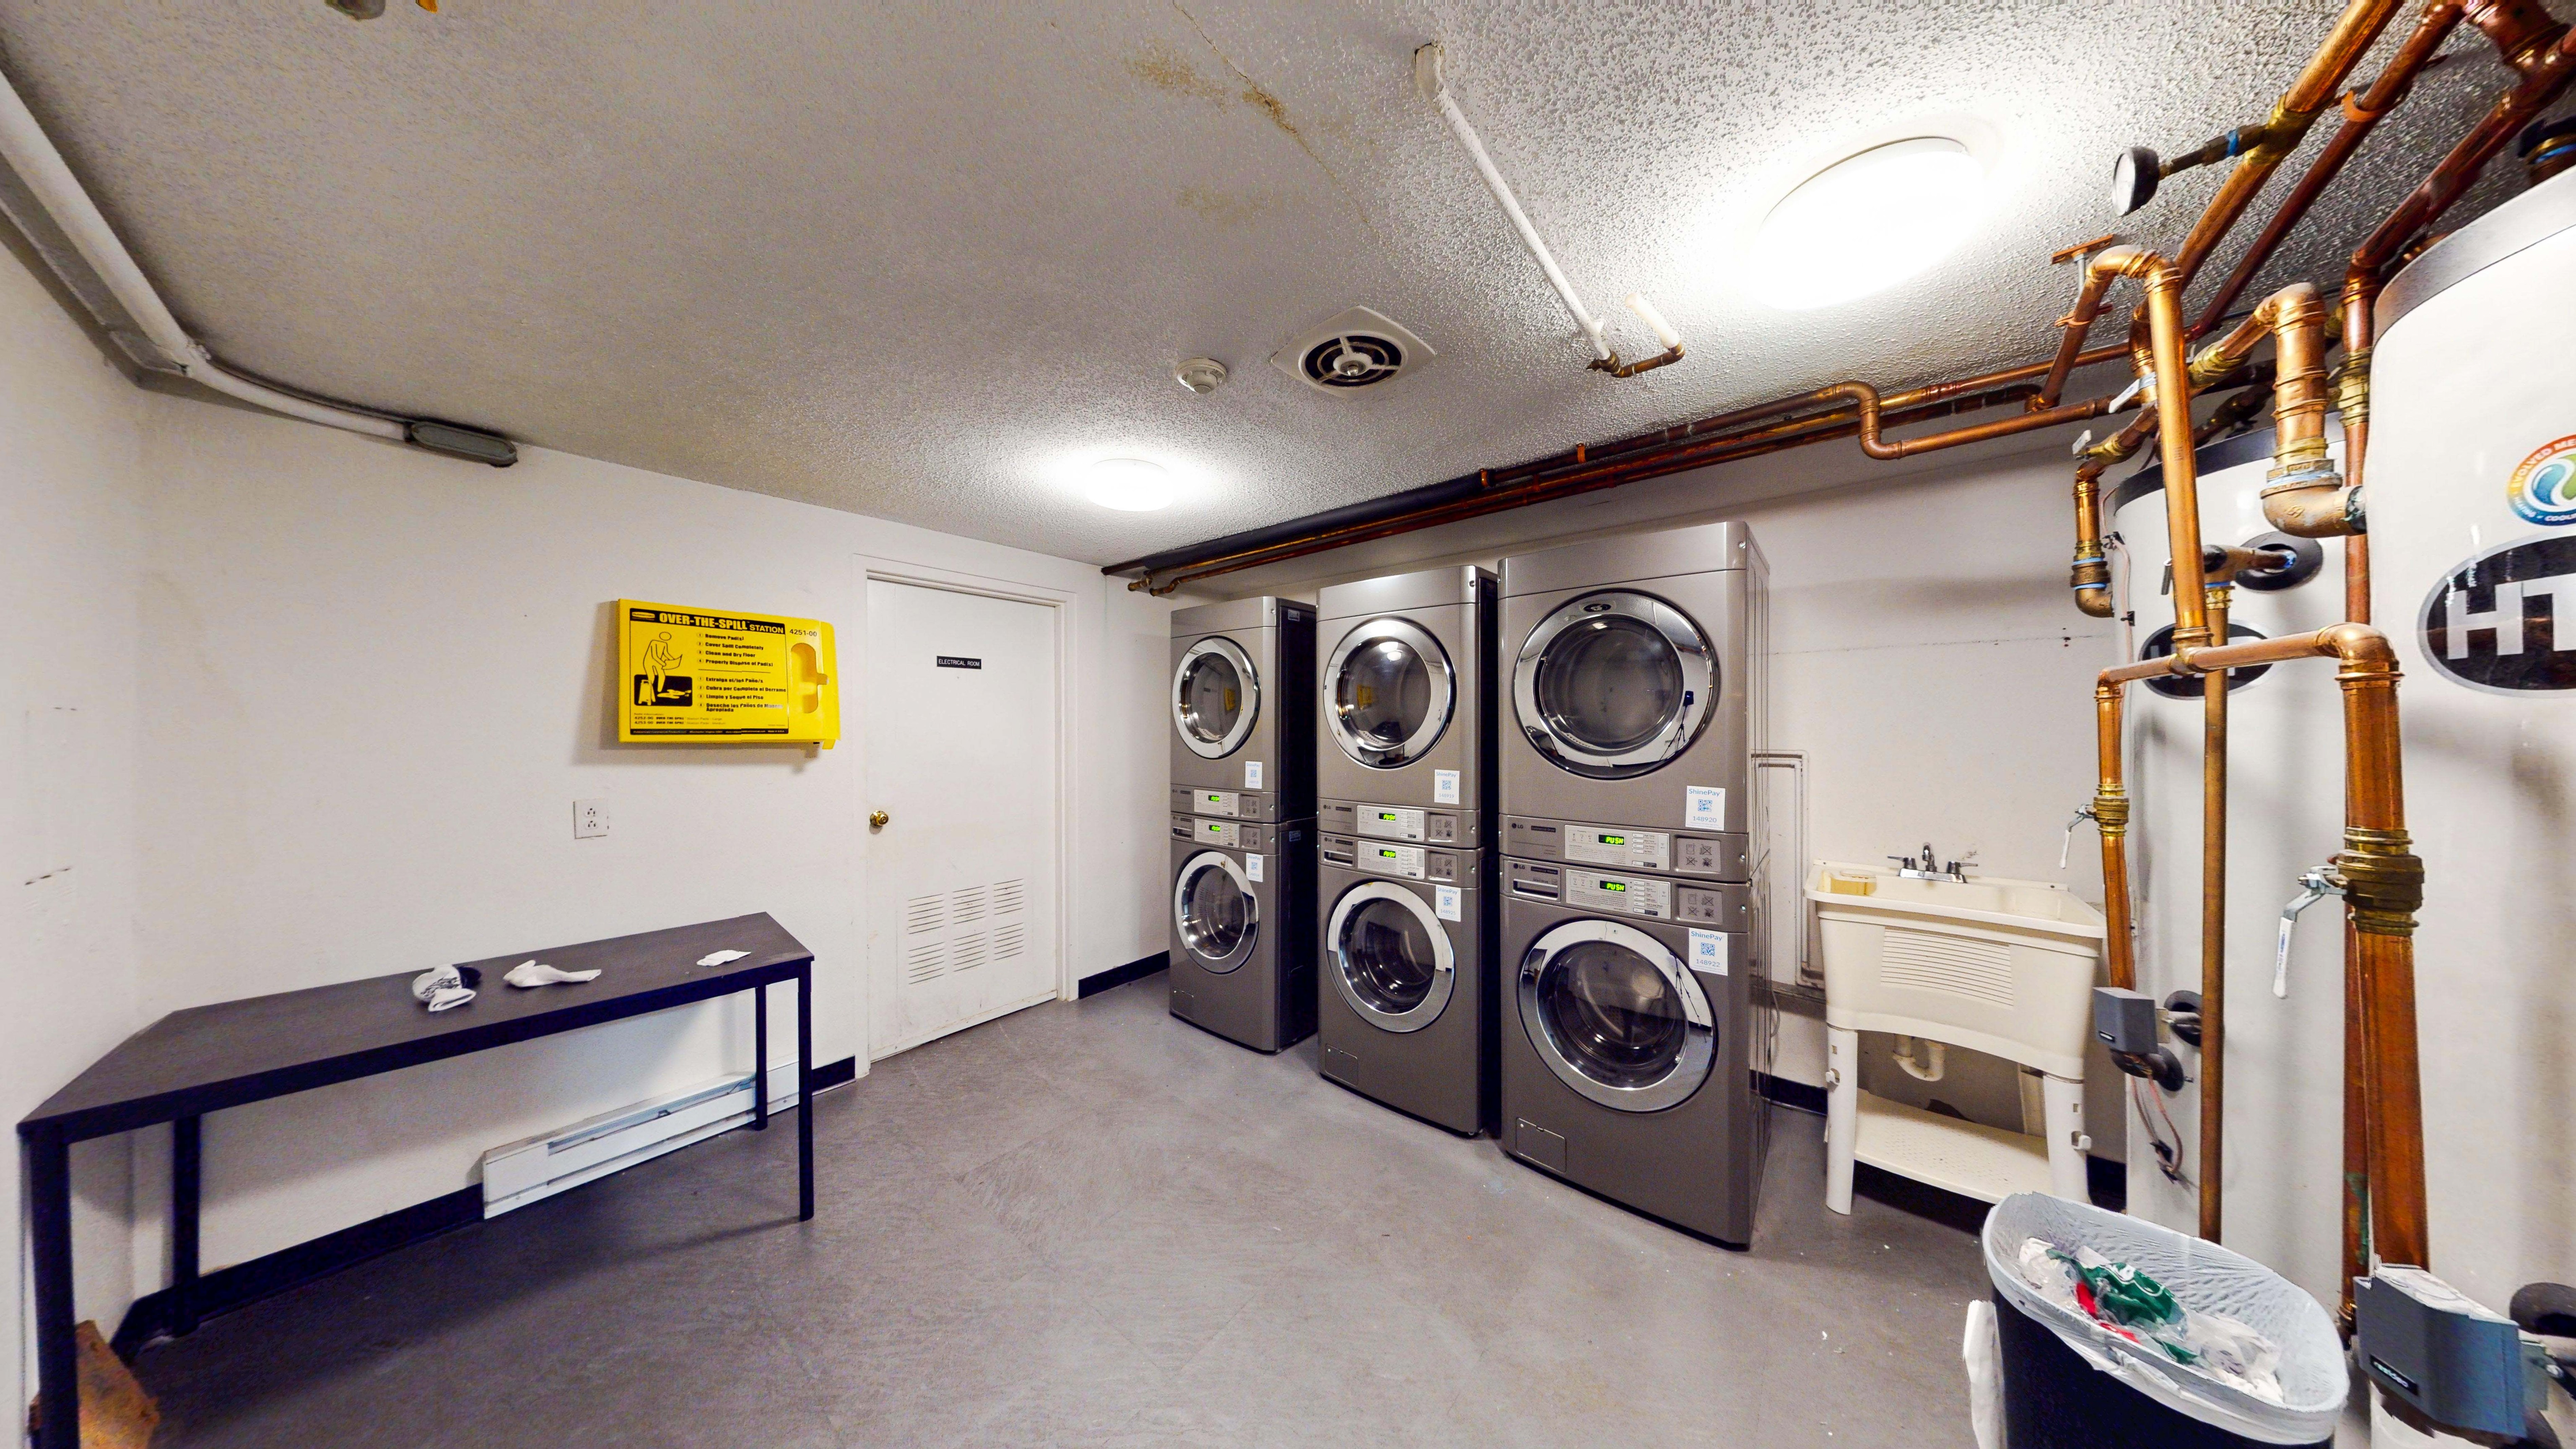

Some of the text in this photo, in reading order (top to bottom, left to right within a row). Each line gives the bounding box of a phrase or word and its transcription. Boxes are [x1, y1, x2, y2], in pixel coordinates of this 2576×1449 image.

[2511, 448, 2553, 488] EVOLVED
[749, 624, 784, 634] STATION
[1607, 883, 1625, 891] PUSH
[1691, 931, 1722, 941] ShinePay
[1696, 959, 1720, 967] 148922
